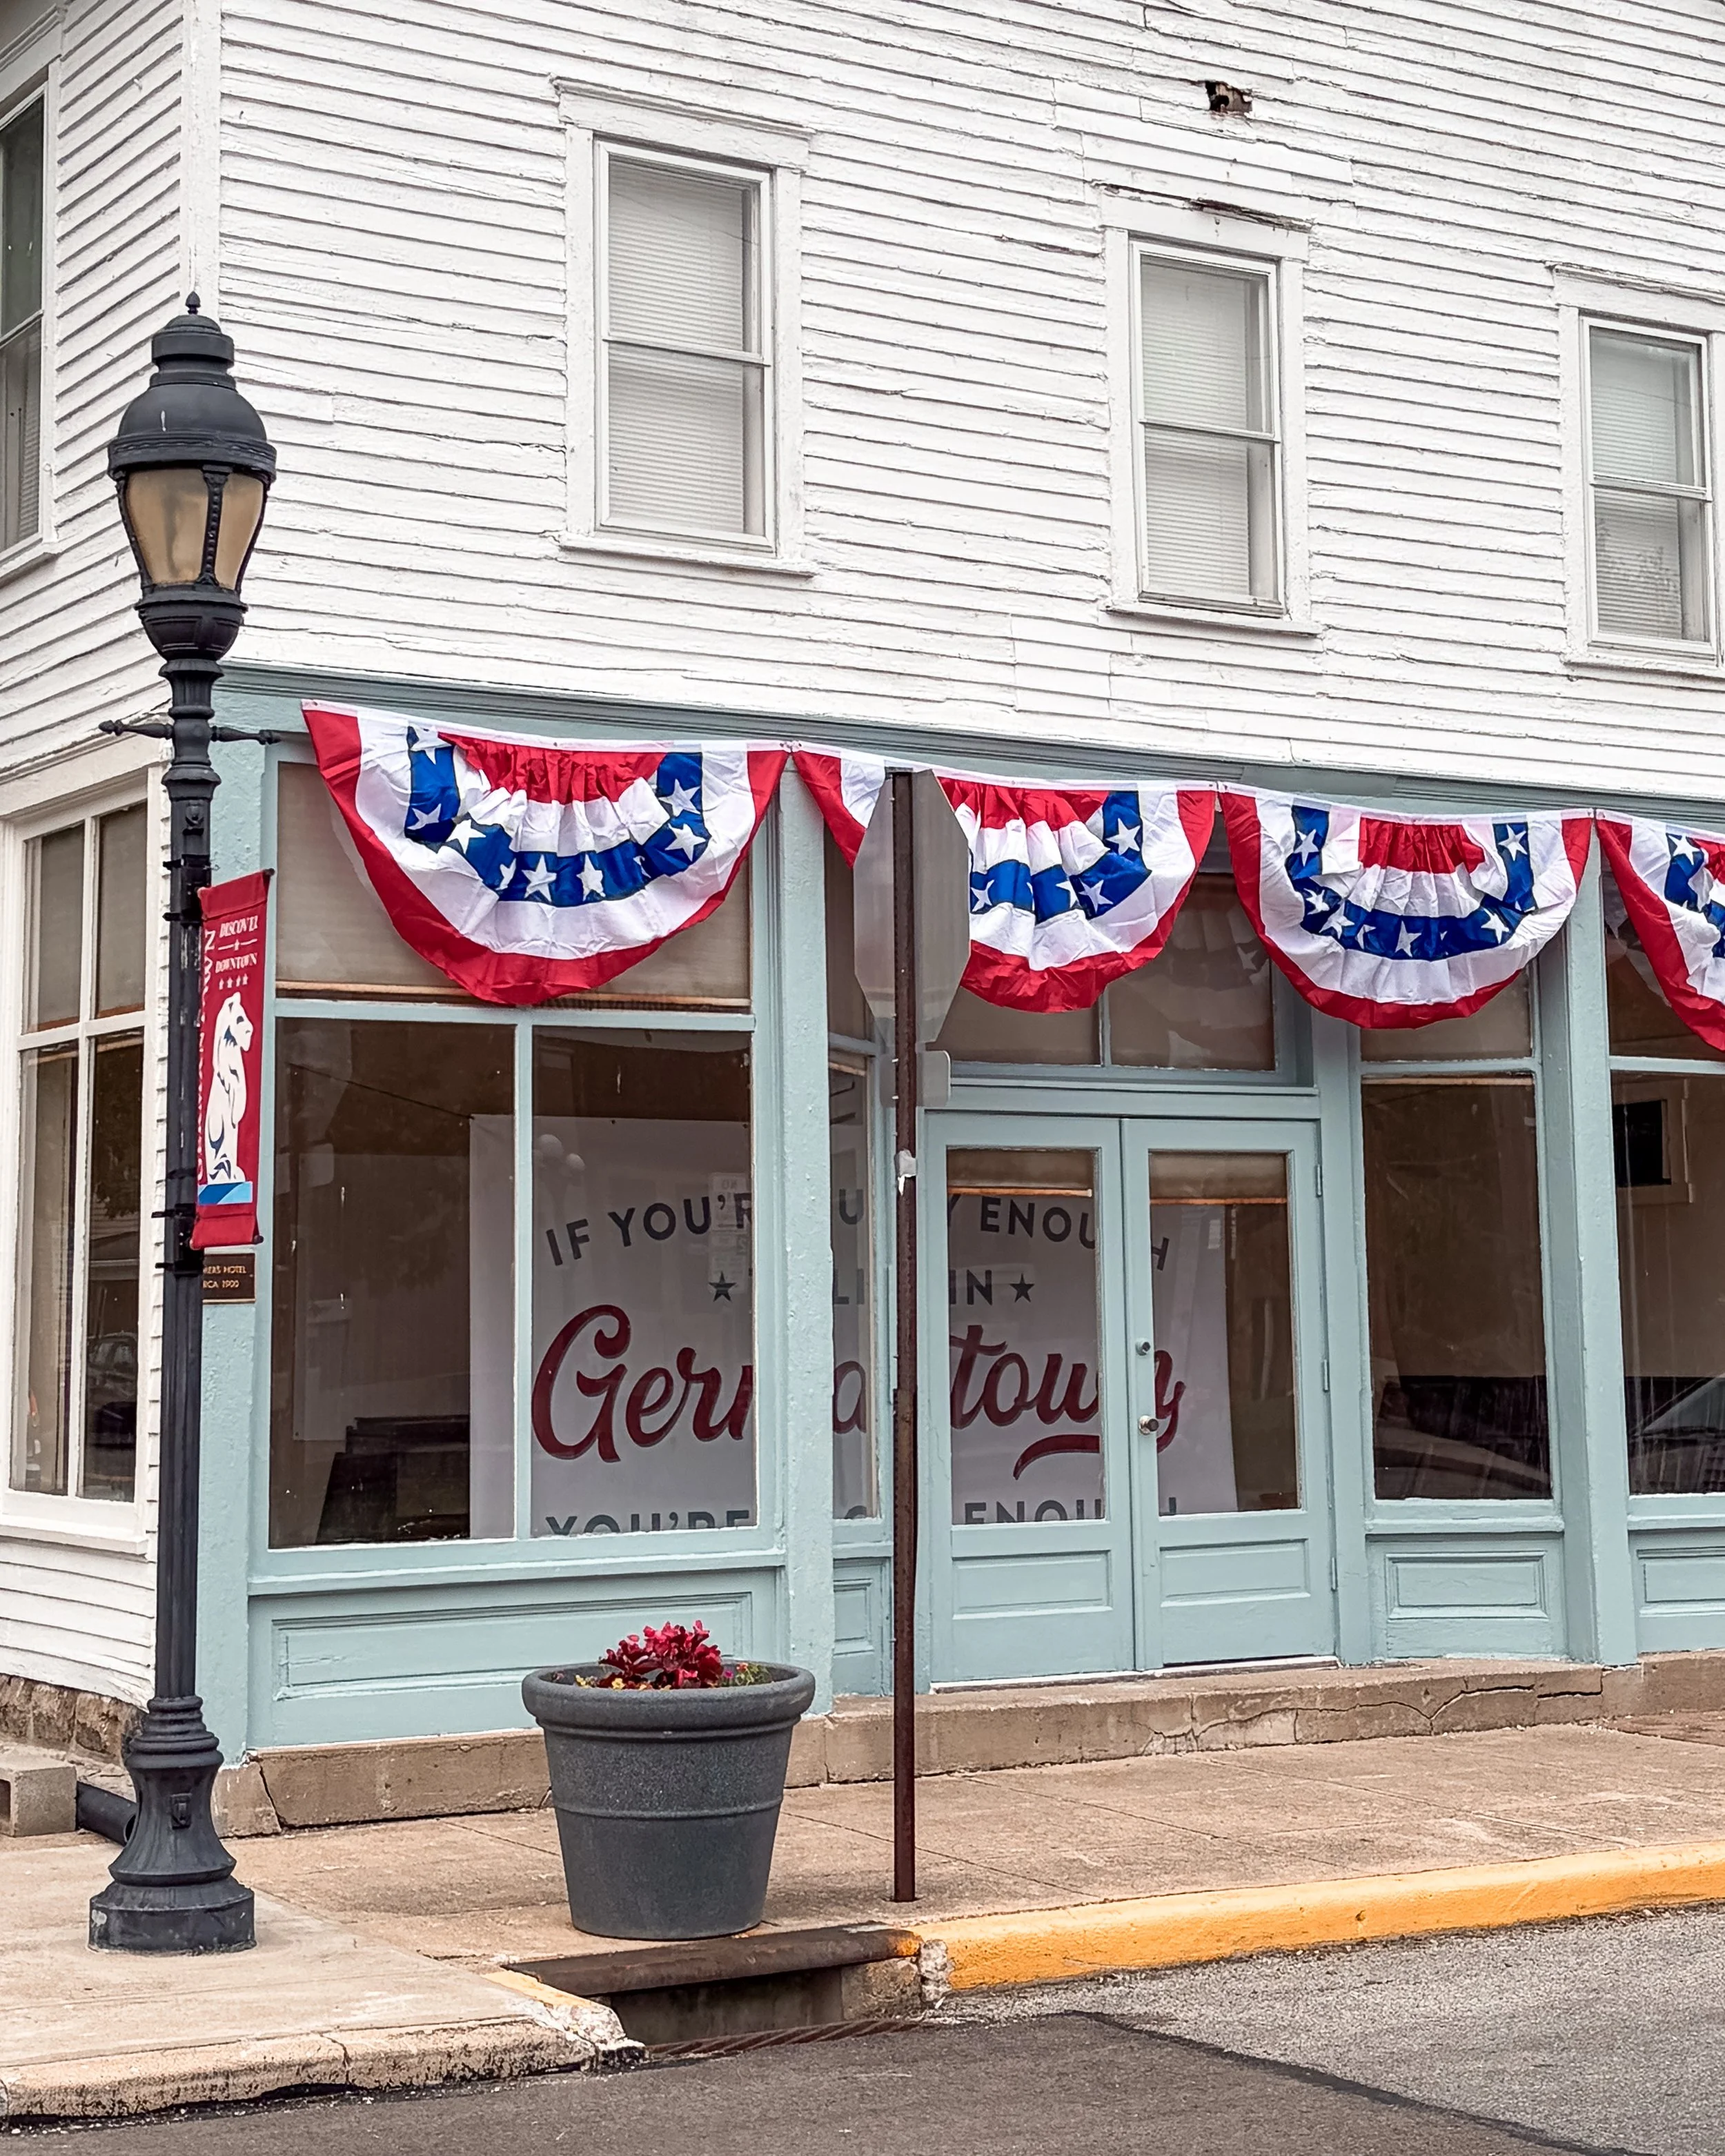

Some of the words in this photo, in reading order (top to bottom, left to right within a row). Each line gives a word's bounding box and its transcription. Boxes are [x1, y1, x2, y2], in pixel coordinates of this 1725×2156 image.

[215, 952, 258, 973] DOWNTOWN
[546, 1218, 590, 1266] IF
[607, 1193, 752, 1247] YOU'R
[980, 1196, 1170, 1272] ENOUH
[223, 1265, 247, 1274] HOTEL
[221, 1279, 240, 1289] 1900
